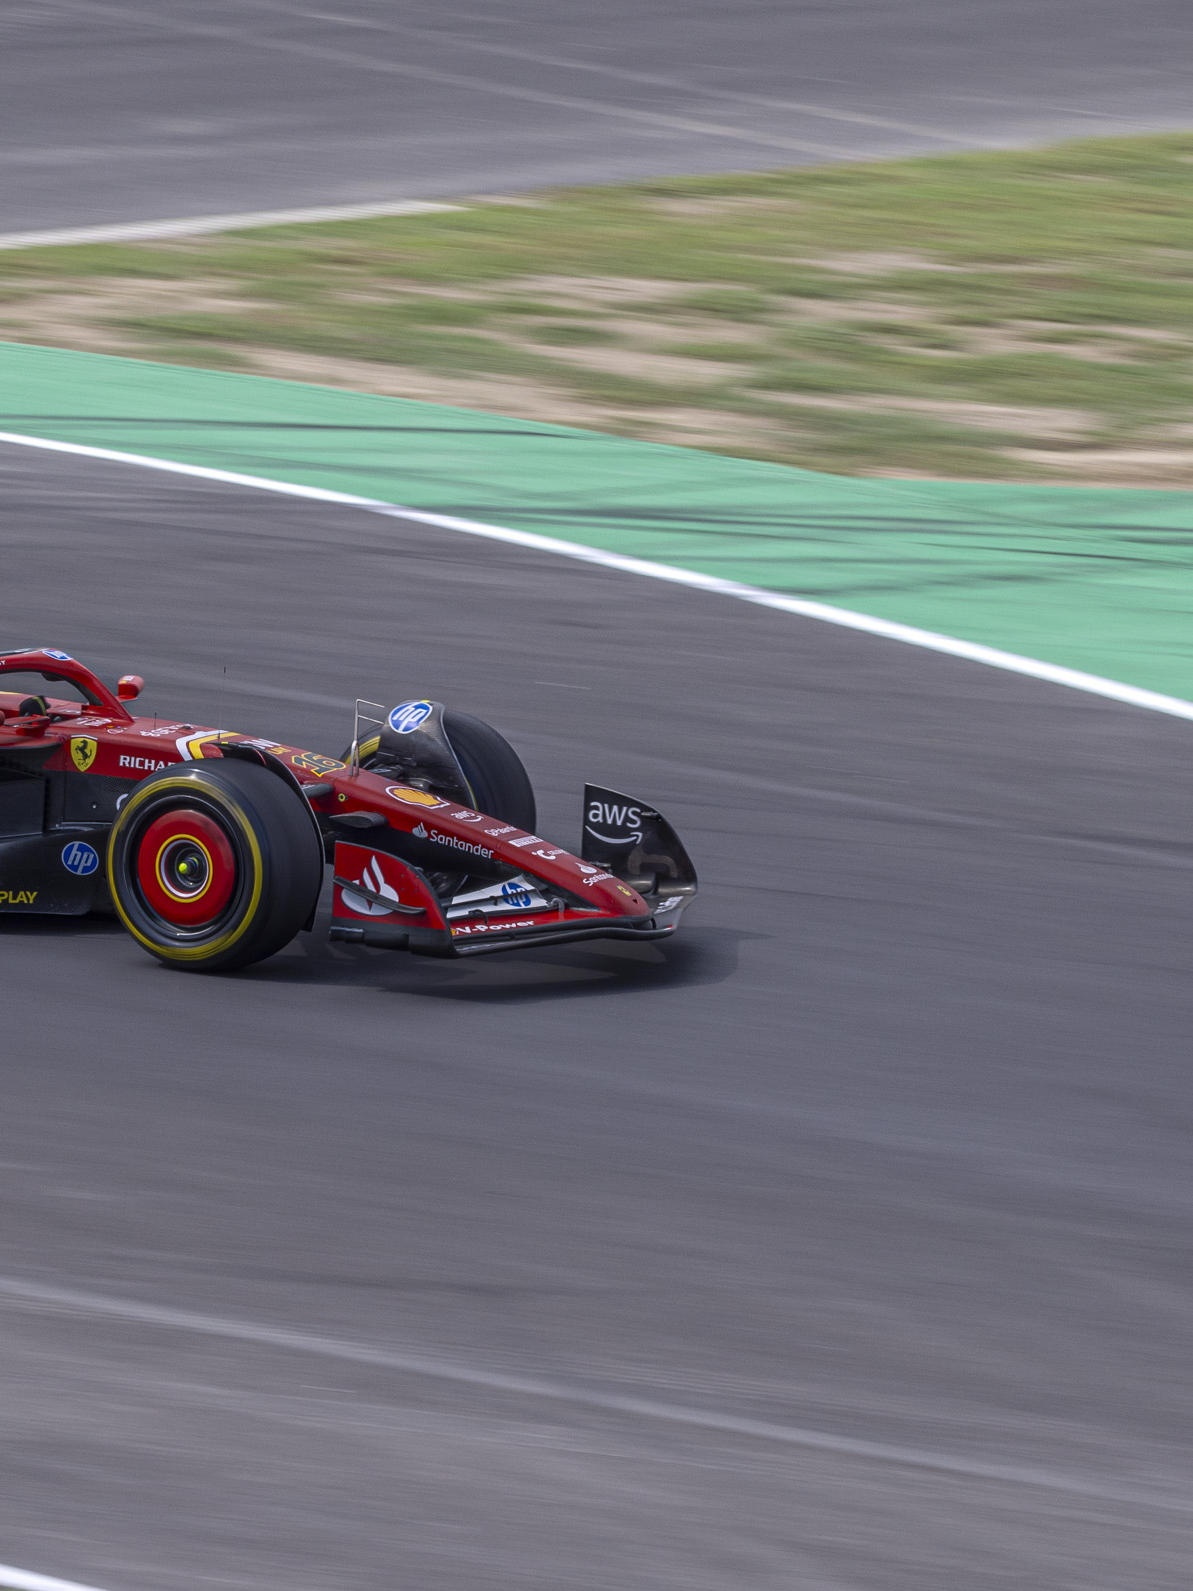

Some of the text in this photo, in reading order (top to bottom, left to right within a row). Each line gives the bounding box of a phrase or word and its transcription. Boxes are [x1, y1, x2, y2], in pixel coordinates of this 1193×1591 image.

[390, 701, 430, 733] hp
[588, 801, 642, 828] aws
[63, 842, 97, 875] hp
[429, 829, 494, 859] Santander
[456, 920, 535, 934] V-Power
